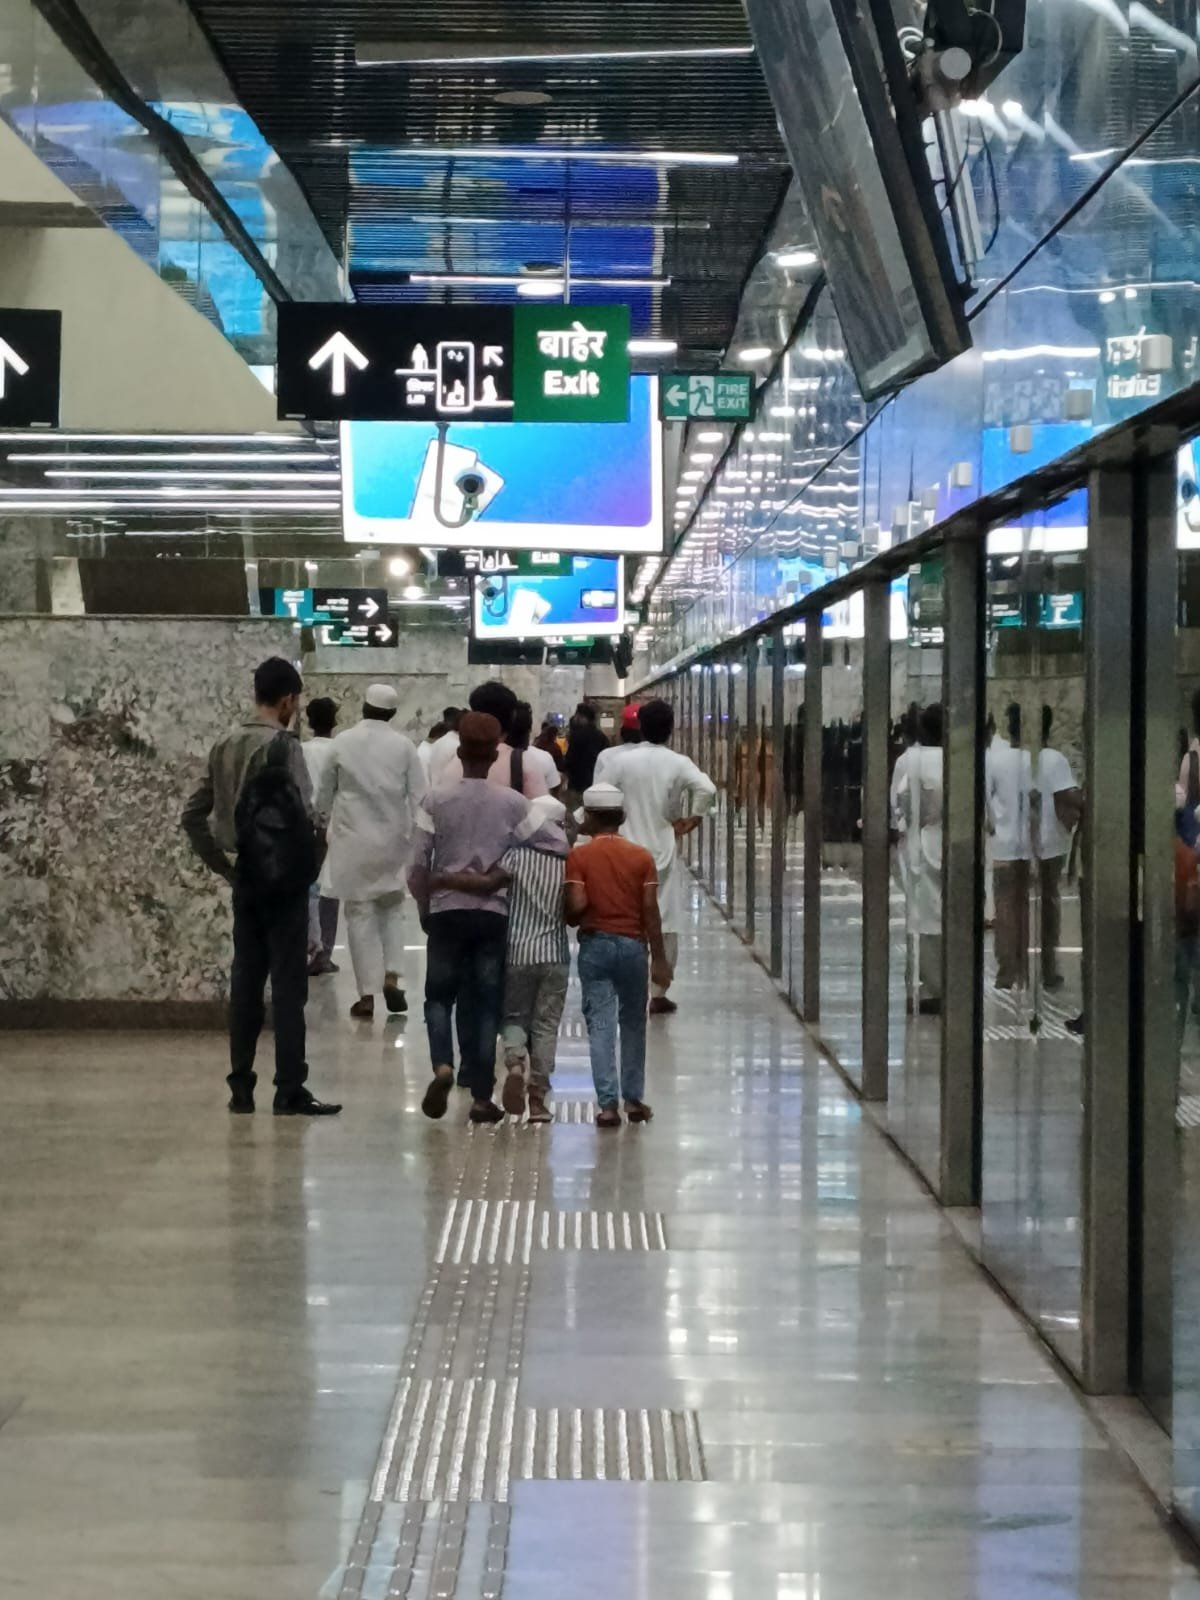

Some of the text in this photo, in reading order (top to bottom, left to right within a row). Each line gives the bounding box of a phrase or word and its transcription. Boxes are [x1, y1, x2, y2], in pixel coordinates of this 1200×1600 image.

[537, 321, 607, 362] बाहेर
[544, 370, 600, 397] Exit
[717, 383, 749, 396] FIRE
[717, 397, 747, 409] EXIT
